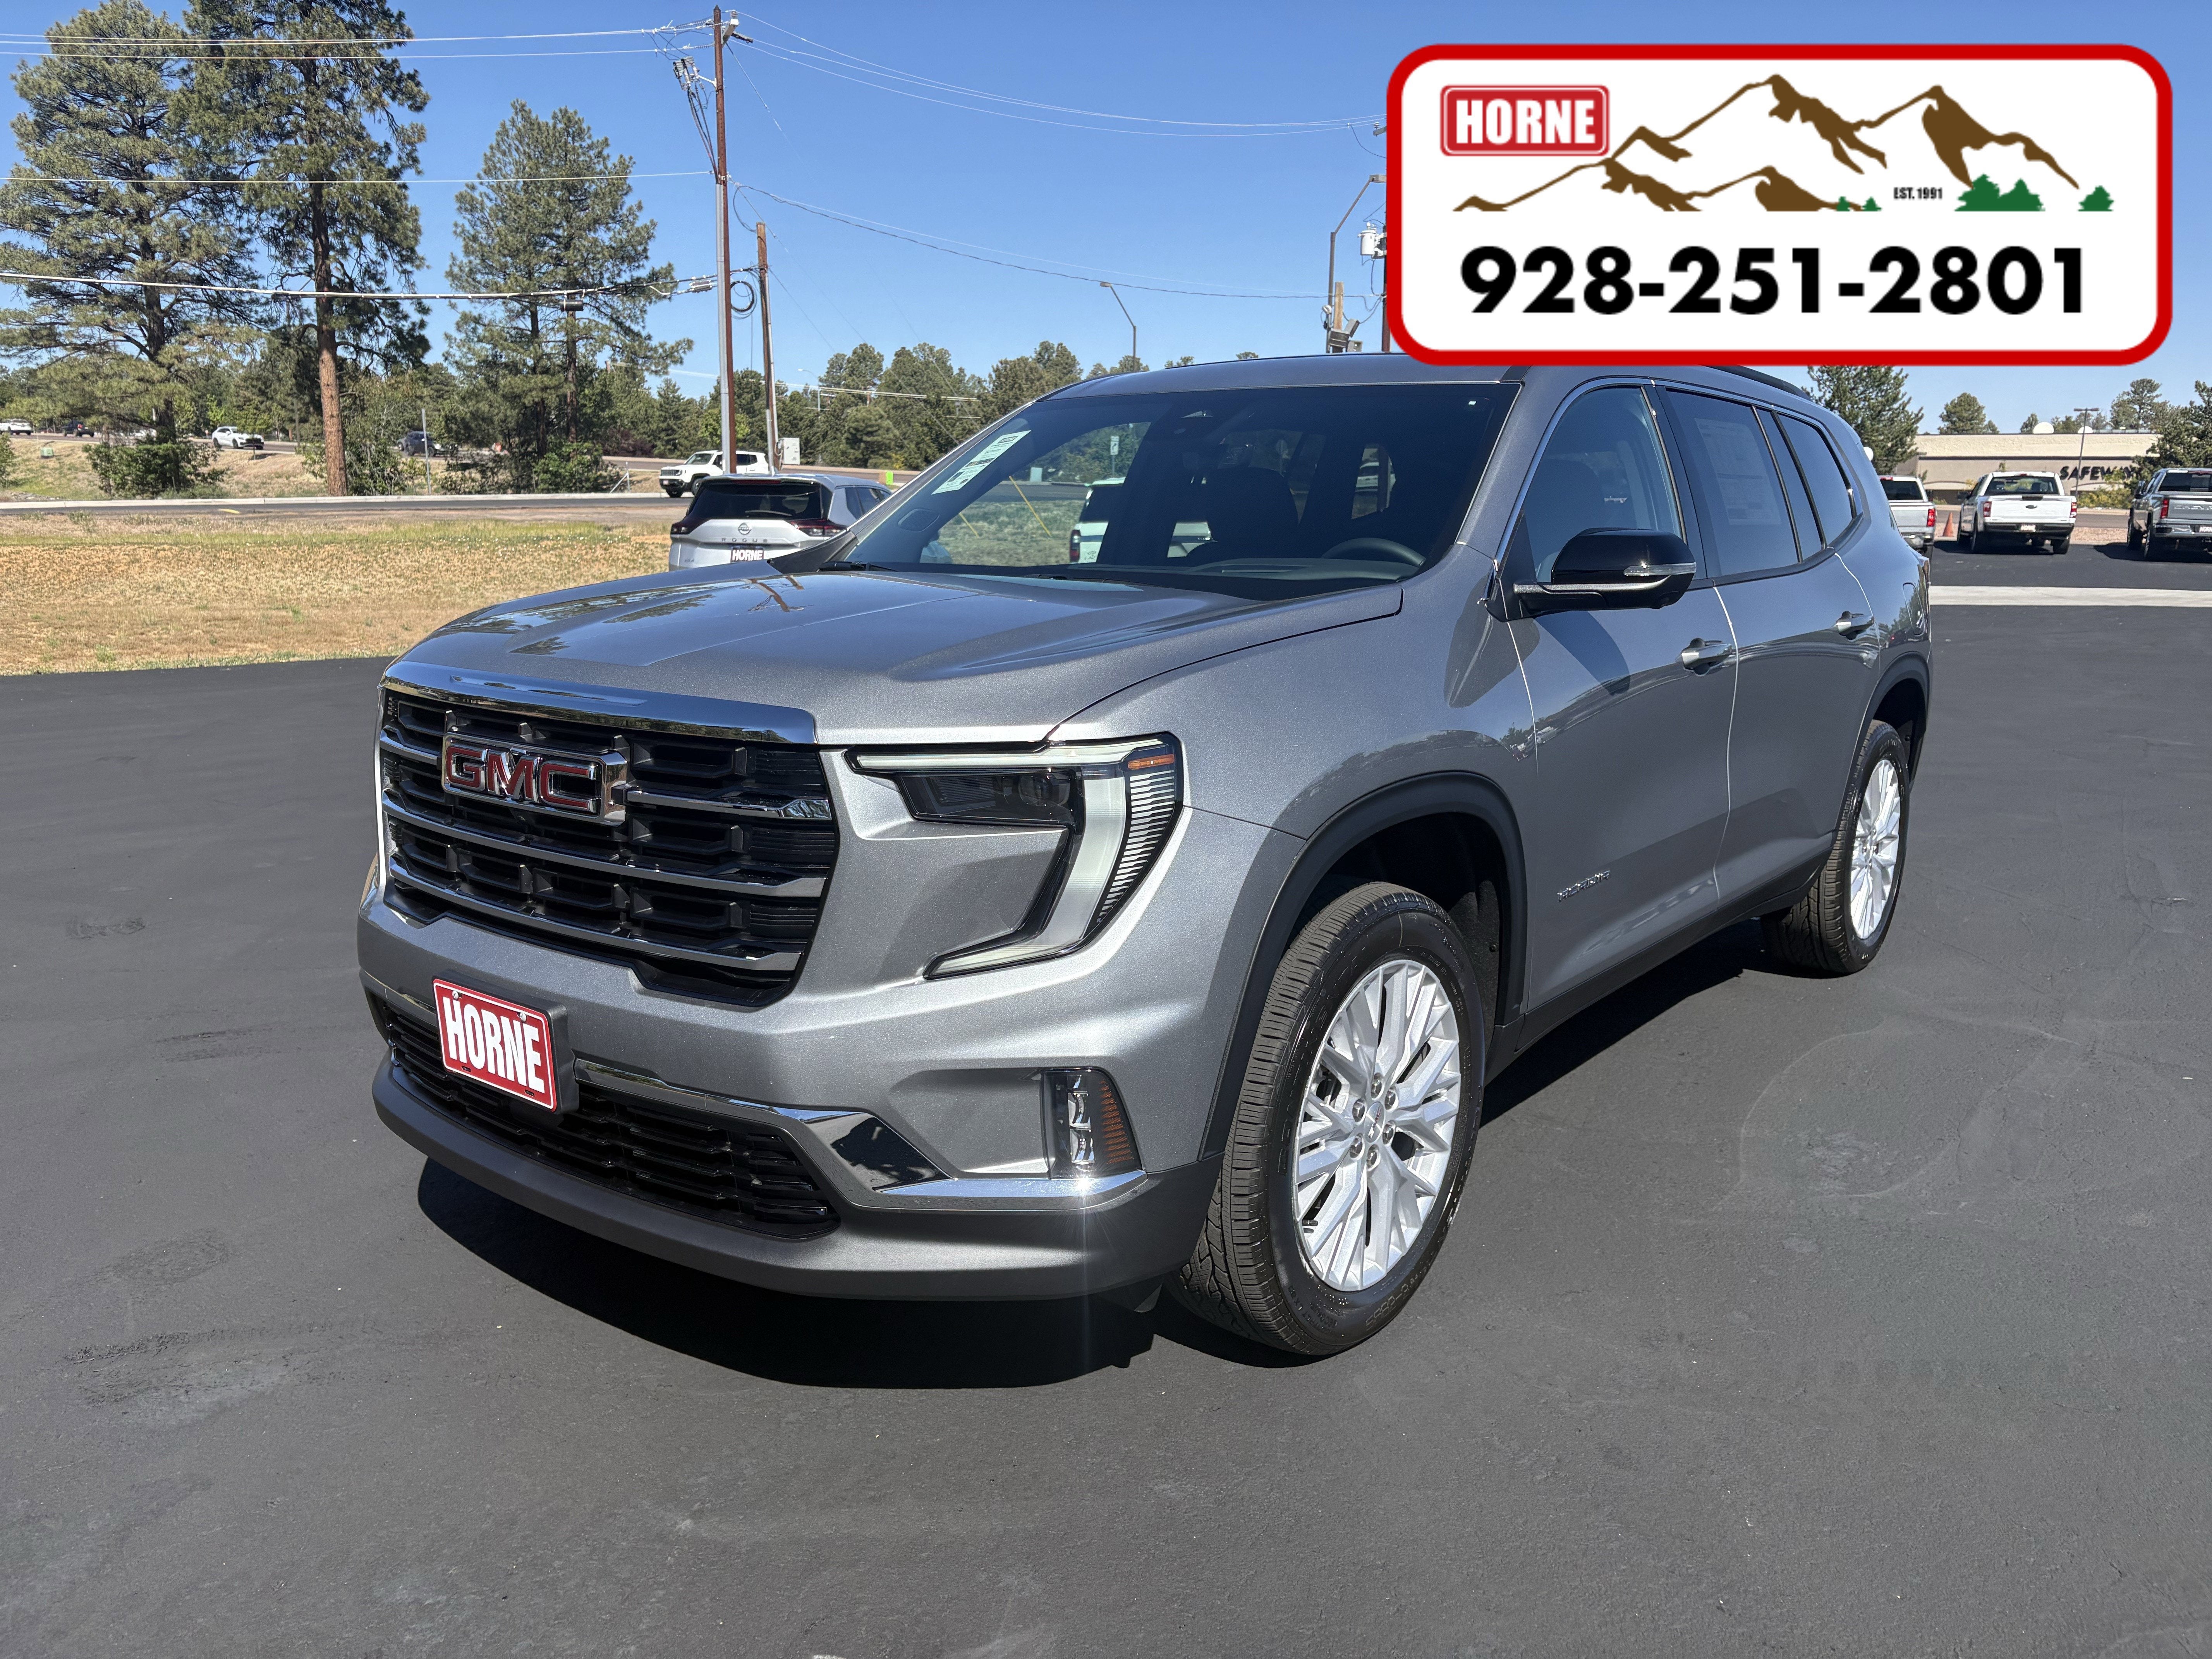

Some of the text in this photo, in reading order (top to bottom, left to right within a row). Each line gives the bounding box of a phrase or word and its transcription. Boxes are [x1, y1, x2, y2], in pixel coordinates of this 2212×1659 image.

[732, 549, 763, 561] HORNE
[445, 744, 599, 815] GMC
[442, 996, 545, 1094] HORNE
